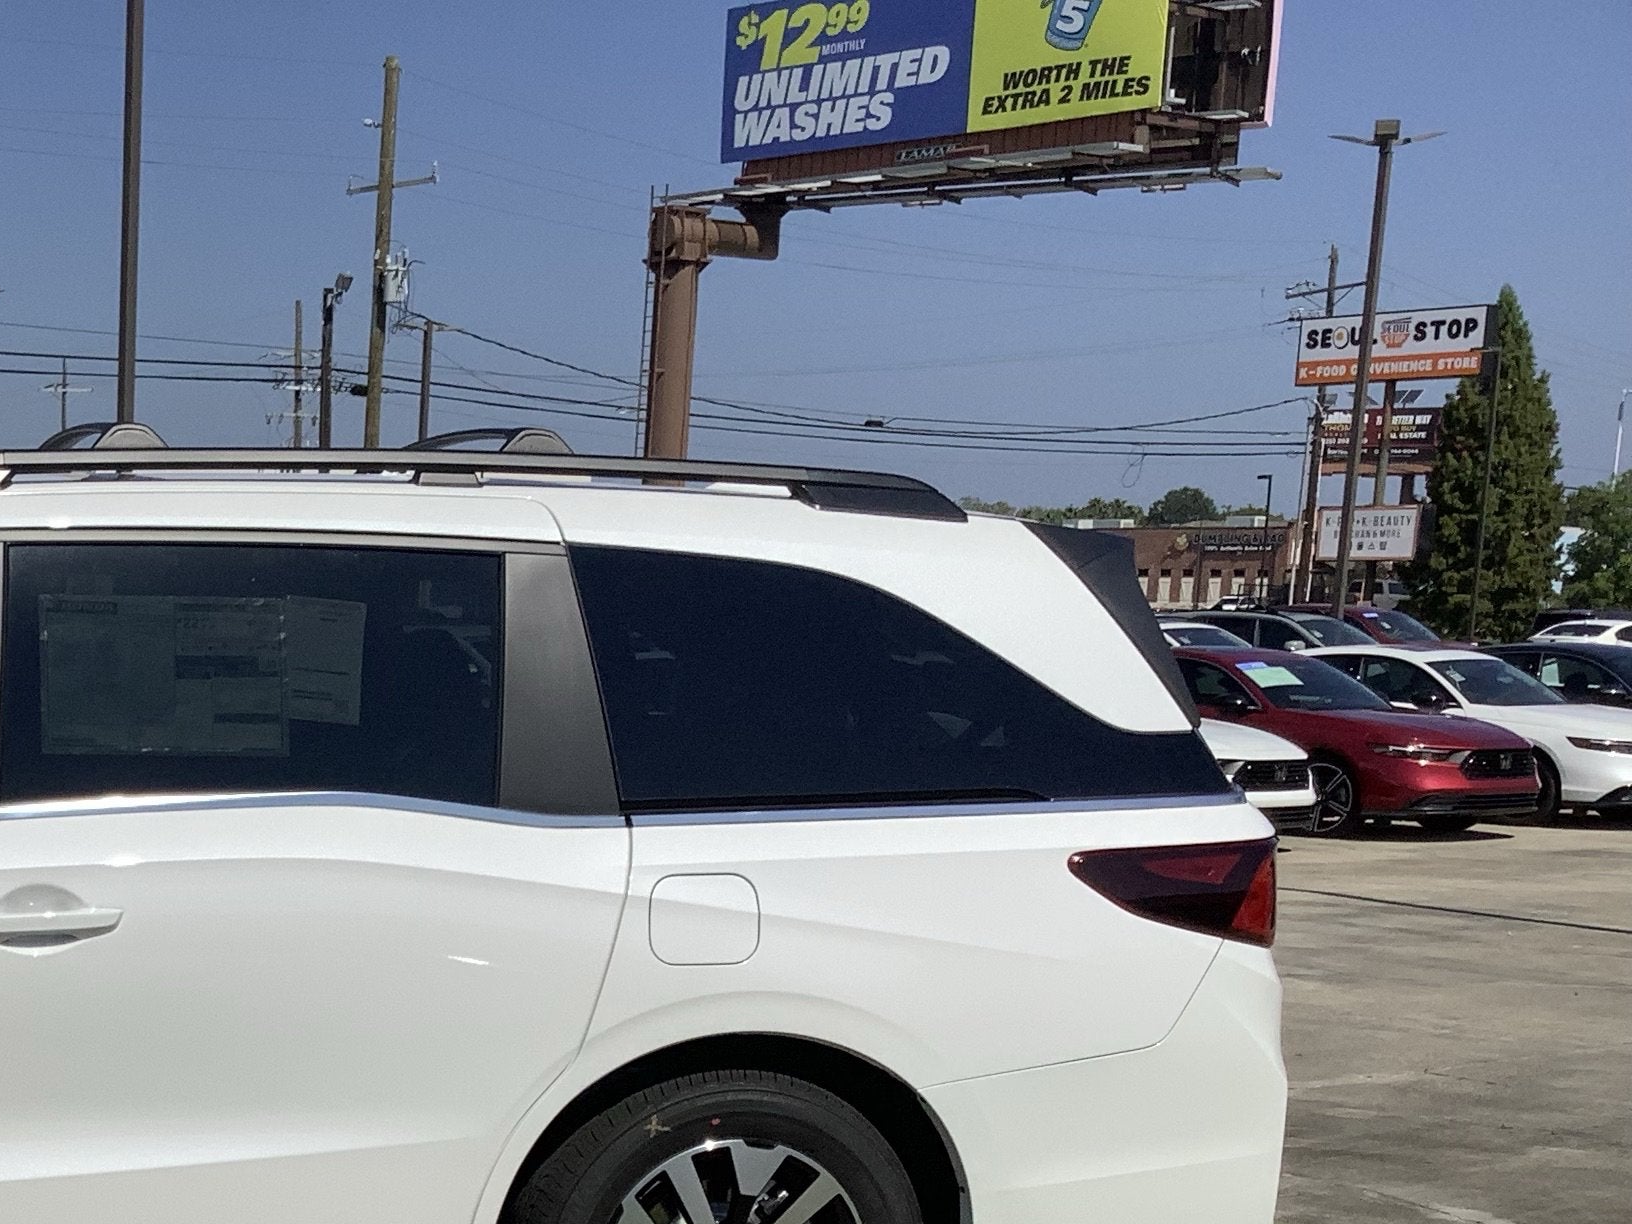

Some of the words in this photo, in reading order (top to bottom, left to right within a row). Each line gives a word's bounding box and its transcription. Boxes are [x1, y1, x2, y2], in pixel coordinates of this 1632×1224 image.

[822, 39, 866, 56] MONTHLY
[734, 46, 951, 111] UNLIMITED
[1002, 61, 1082, 92] WORTH
[1088, 55, 1132, 79] THE
[981, 88, 1051, 116] EXTRA
[1057, 85, 1074, 105] 2
[1078, 75, 1151, 102] MILES
[733, 92, 895, 148] WASHES
[1305, 325, 1378, 350] SEOU
[1413, 317, 1479, 342] STOP
[1298, 364, 1347, 380] K-FOOD
[1351, 357, 1434, 378] CNVENIENCE
[1437, 355, 1479, 371] STORE
[1399, 431, 1428, 439] ESTATE
